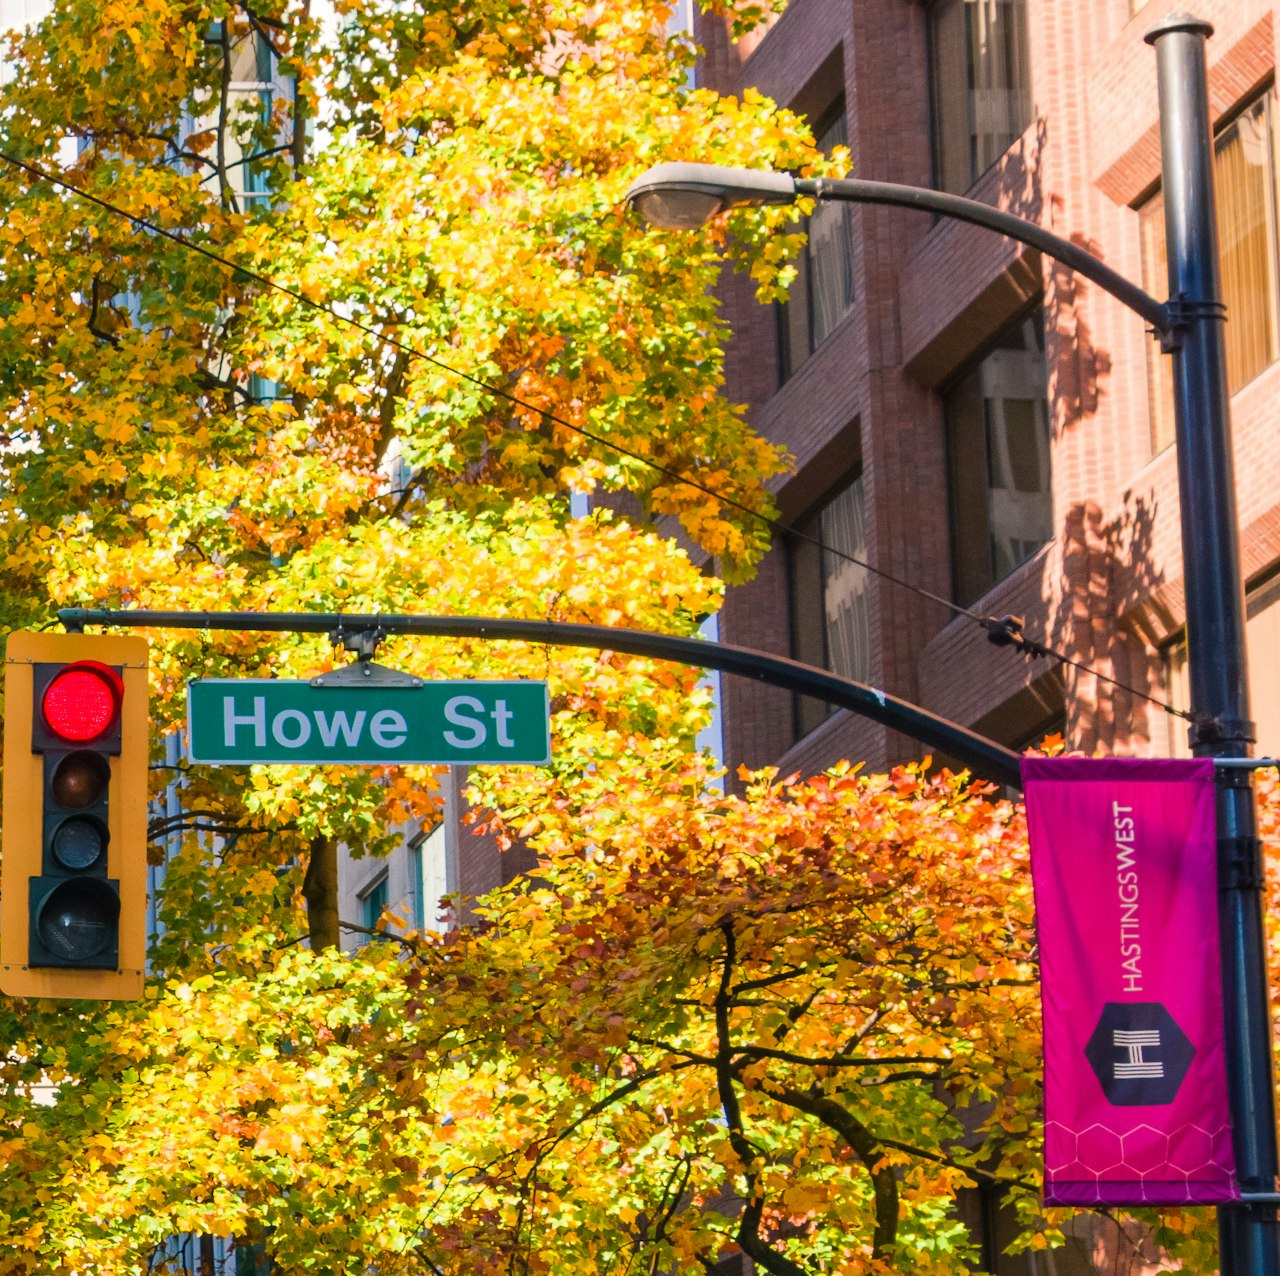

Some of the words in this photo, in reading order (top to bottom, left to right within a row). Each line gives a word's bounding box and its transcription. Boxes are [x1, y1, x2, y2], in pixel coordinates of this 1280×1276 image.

[223, 696, 408, 748] Howe
[443, 696, 515, 748] St
[1113, 801, 1143, 992] HASTINGSWEST
